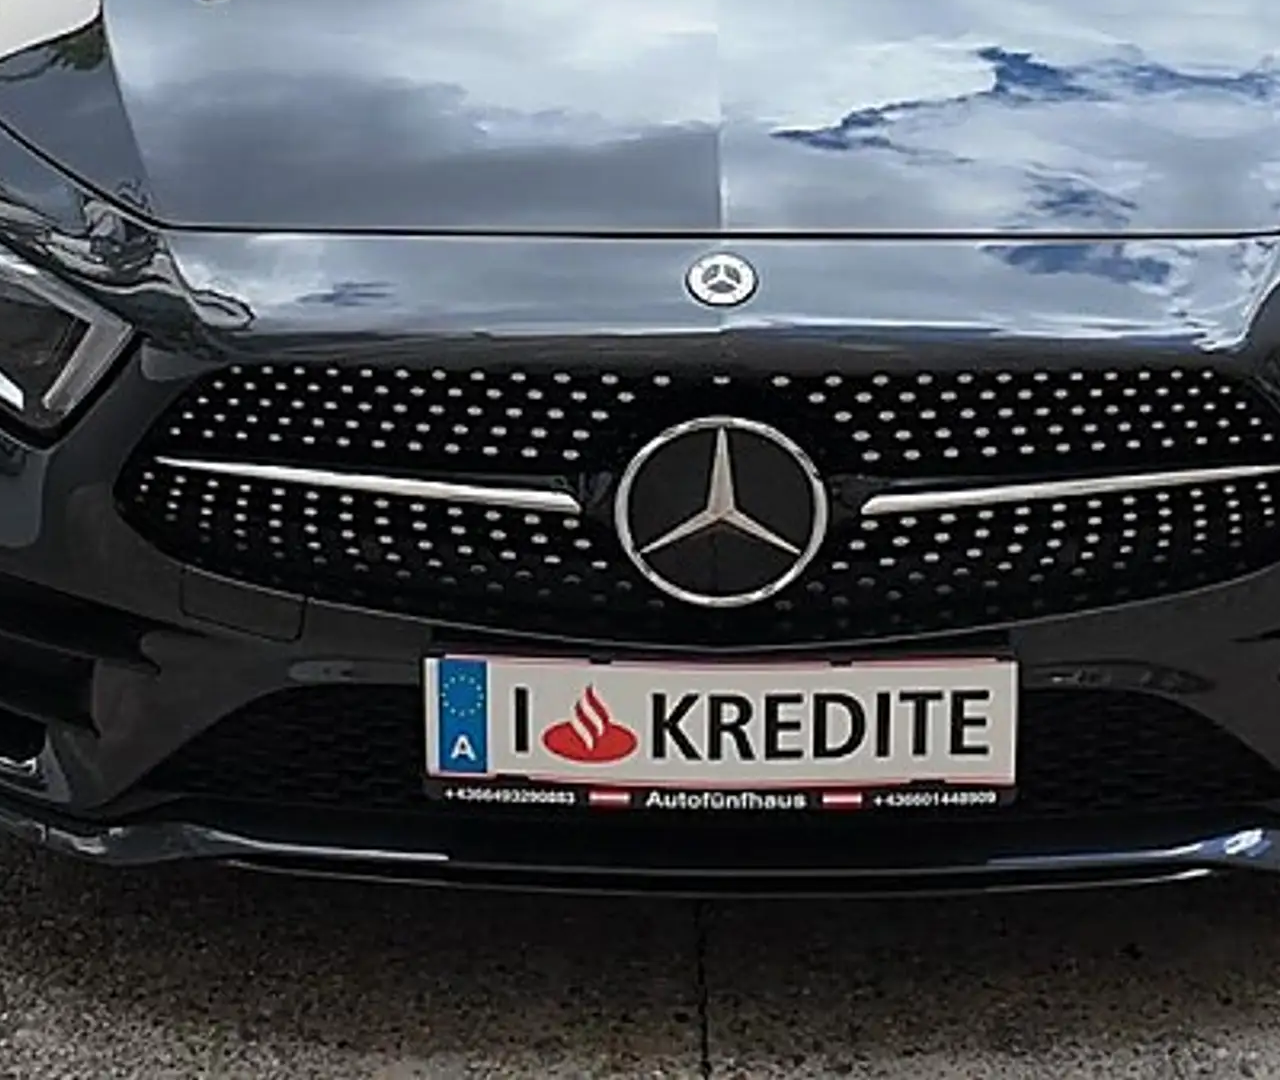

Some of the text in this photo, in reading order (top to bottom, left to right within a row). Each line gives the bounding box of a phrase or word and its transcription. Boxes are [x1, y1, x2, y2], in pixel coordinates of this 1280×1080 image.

[515, 687, 990, 761] I KREDITE
[450, 735, 476, 761] A
[645, 790, 807, 809] Autofünfhaus
